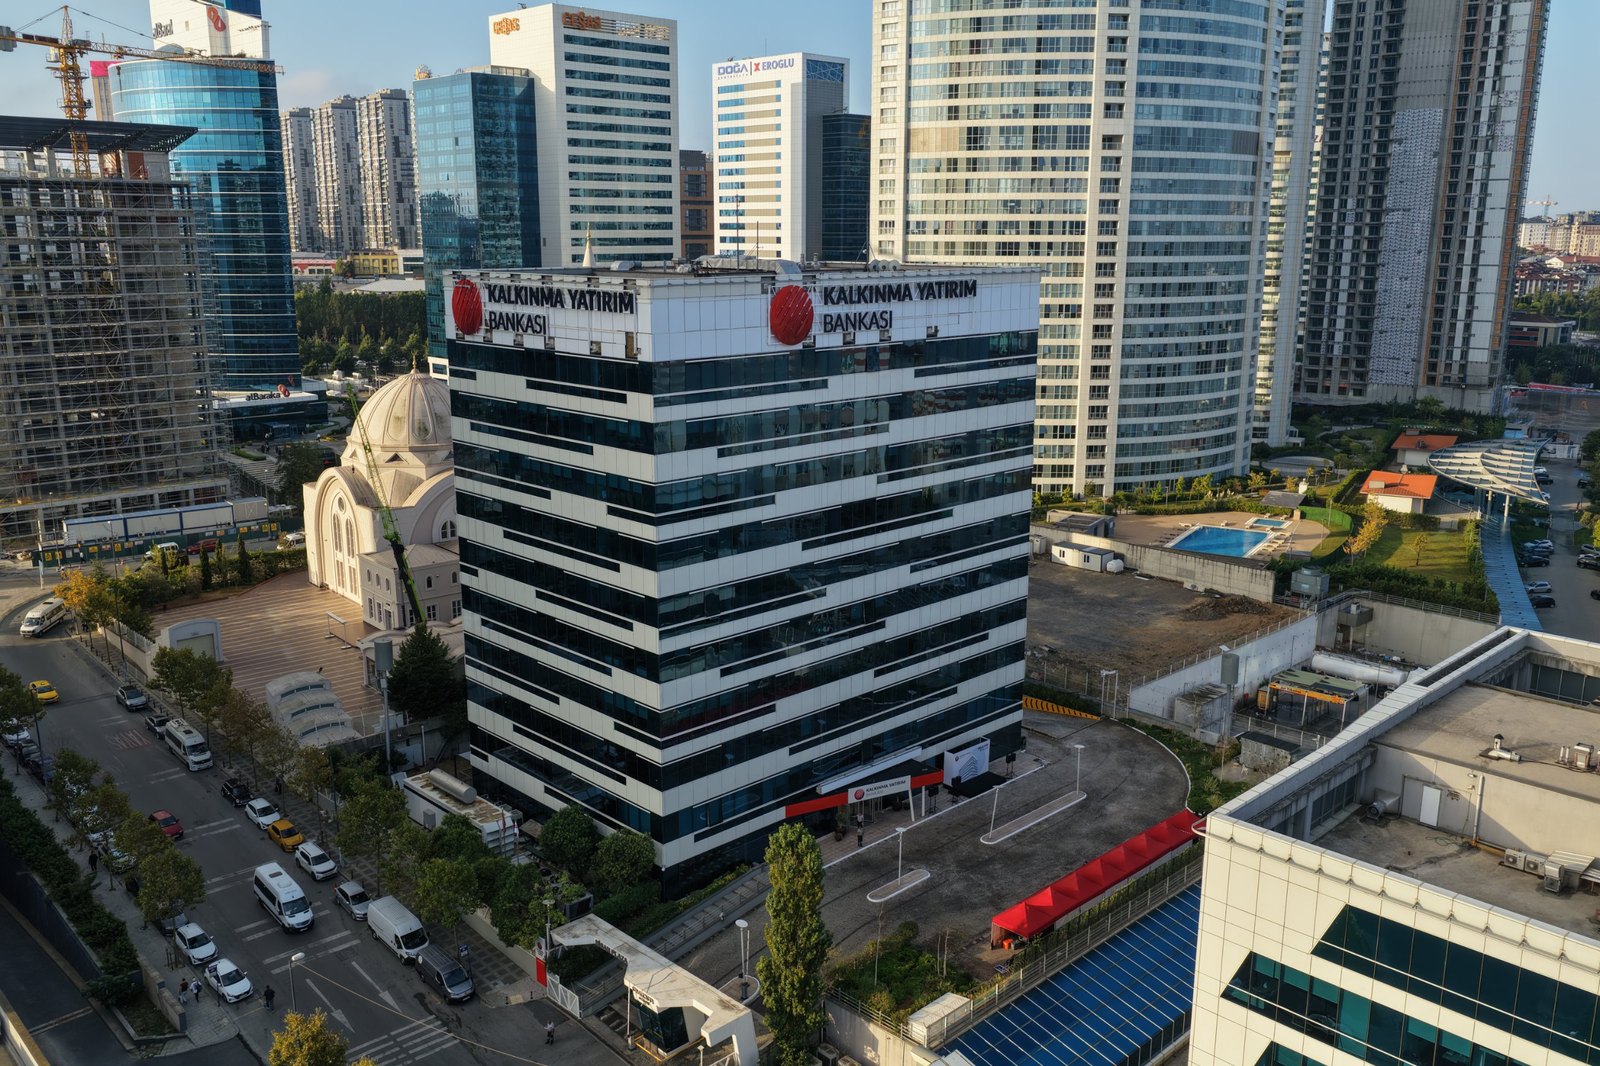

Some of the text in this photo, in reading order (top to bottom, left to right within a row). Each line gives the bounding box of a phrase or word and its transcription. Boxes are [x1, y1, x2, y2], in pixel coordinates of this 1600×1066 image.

[718, 62, 748, 75] DOĞA
[762, 58, 795, 71] EROGLU
[487, 284, 634, 314] KALKINMA YATIRIM
[823, 279, 977, 305] KALKINMA YATIRIM
[489, 311, 546, 335] BANKASI
[823, 310, 893, 333] BANKASI
[246, 391, 281, 401] alBaraka
